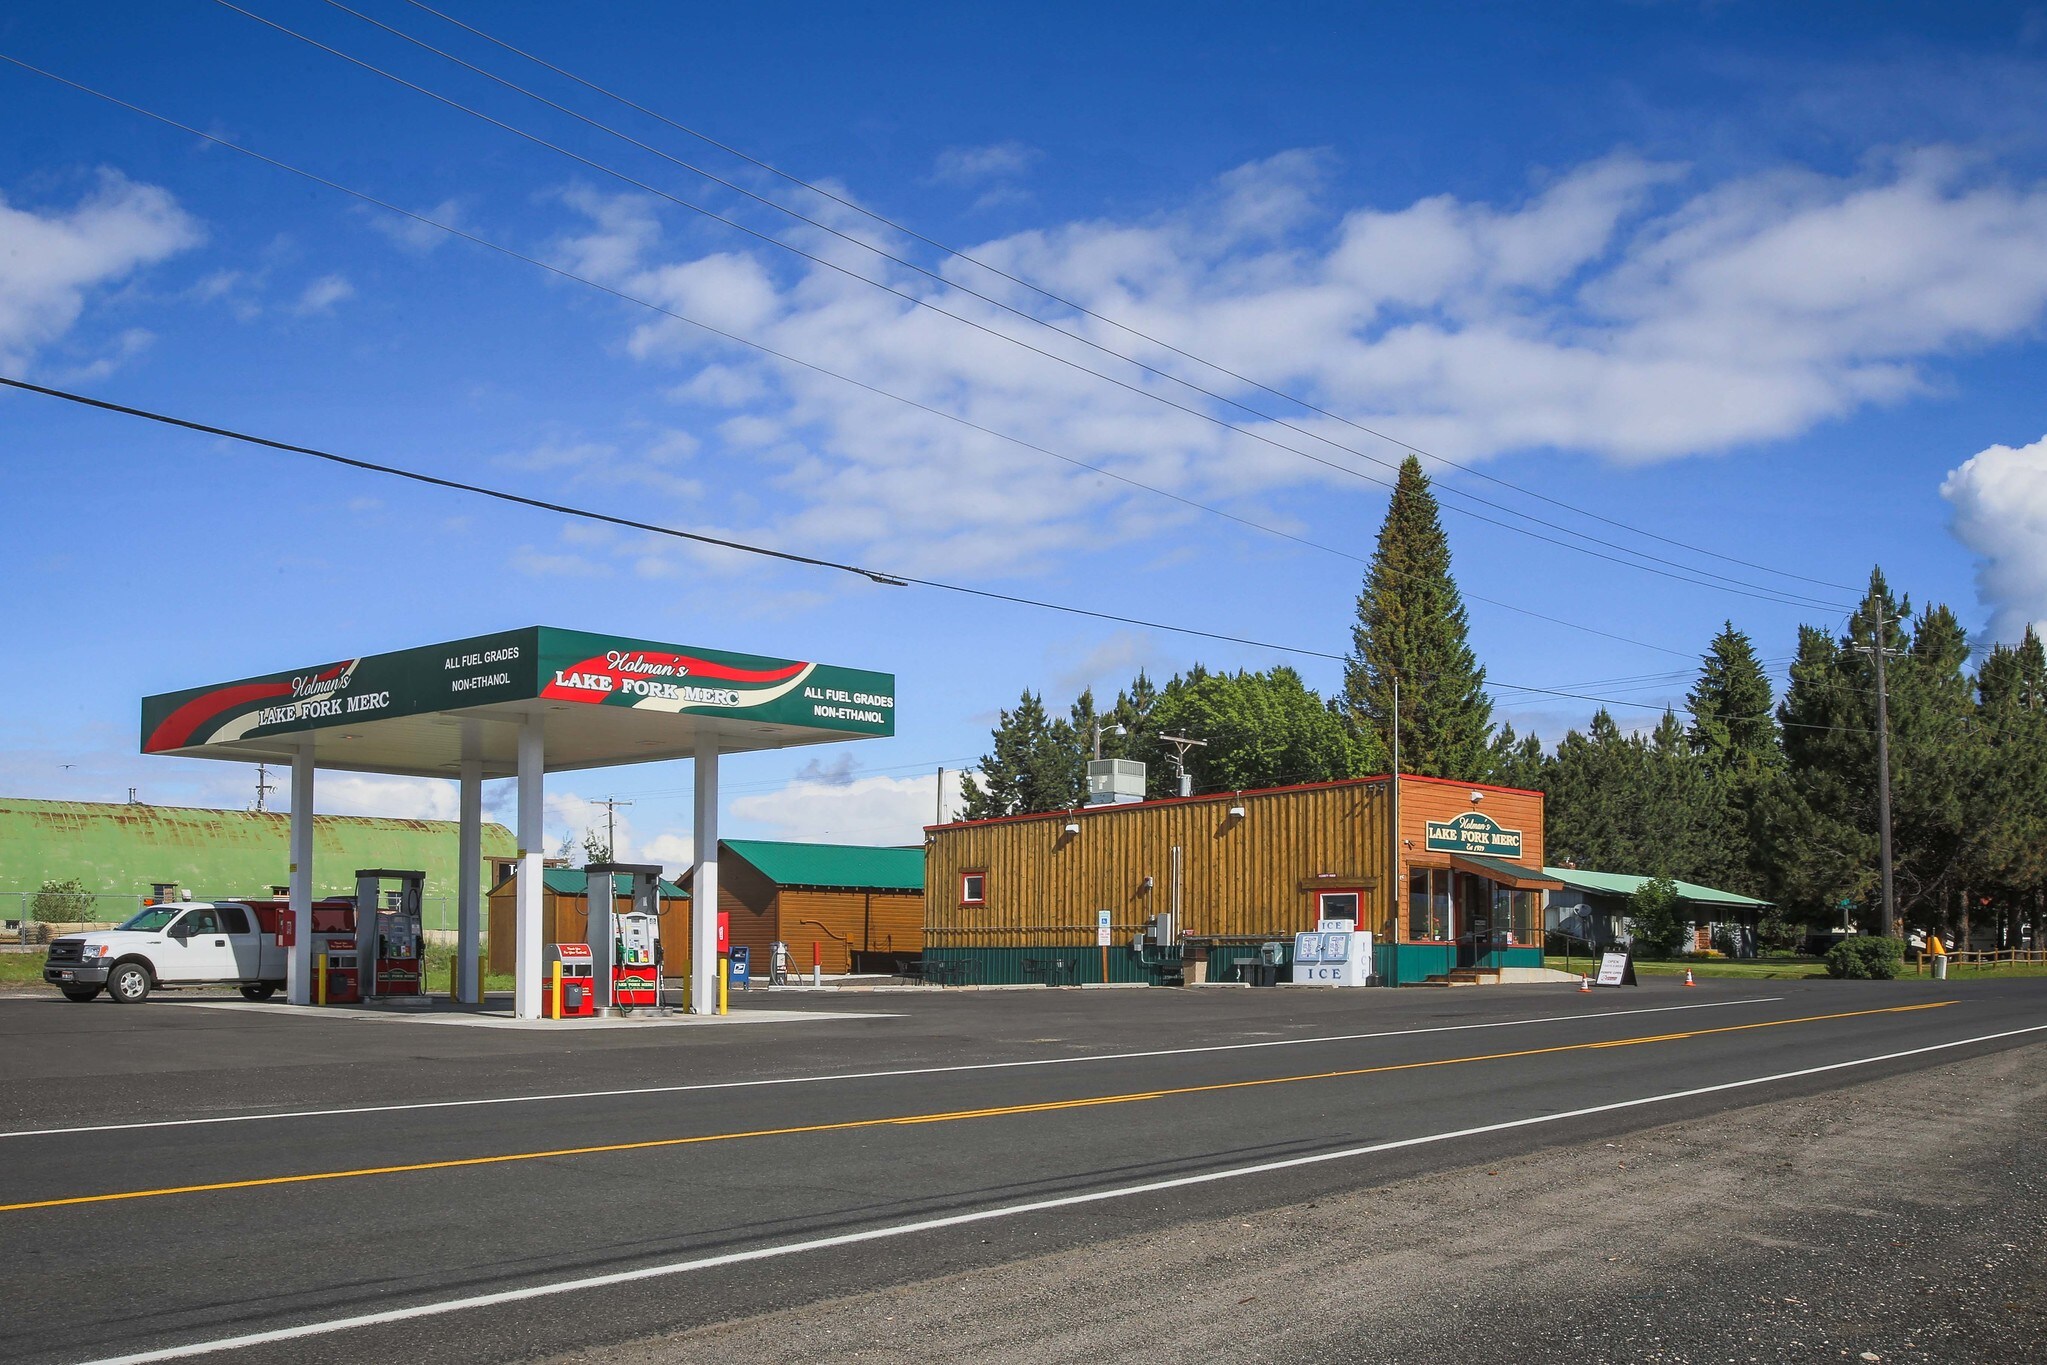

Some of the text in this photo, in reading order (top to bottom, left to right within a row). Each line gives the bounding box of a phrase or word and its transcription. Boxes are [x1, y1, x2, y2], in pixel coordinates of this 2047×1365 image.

[444, 646, 520, 670] ALL FUEL GRADES
[605, 650, 689, 677] Holman's
[291, 667, 352, 698] Holman's
[452, 672, 511, 692] NON-ETHANOL
[555, 670, 740, 706] LAKE FORK MERC
[804, 686, 894, 708] ALL FUEL GRADES
[258, 691, 390, 726] LAKE FORK MERC
[814, 704, 885, 723] NON-ETHANOL
[1459, 816, 1492, 831] Holman's
[1428, 827, 1520, 847] LAKE FORK MERC
[1322, 922, 1342, 930] ICE
[1308, 968, 1342, 979] ICE
